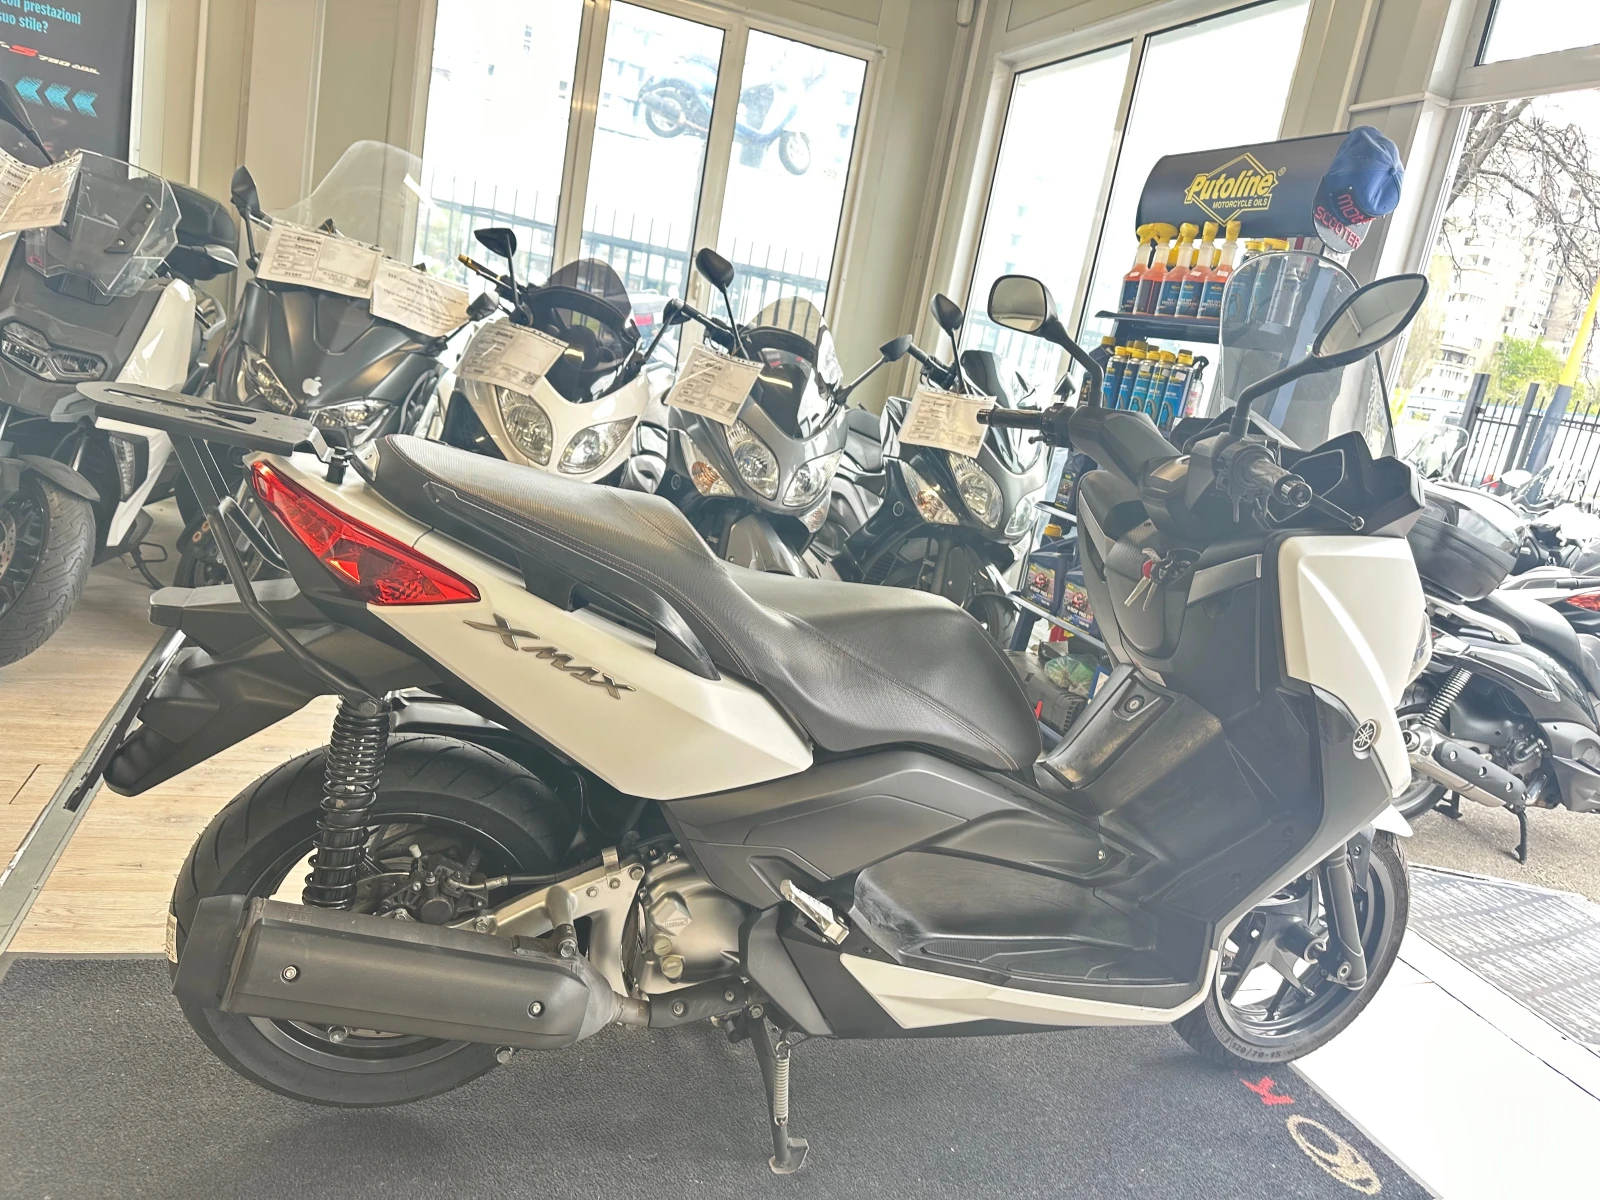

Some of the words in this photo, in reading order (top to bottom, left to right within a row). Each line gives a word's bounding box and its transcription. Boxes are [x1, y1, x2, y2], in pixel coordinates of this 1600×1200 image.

[18, 16, 48, 34] stile?
[23, 0, 81, 25] prestazioni
[1185, 170, 1276, 202] Putoline
[1212, 199, 1253, 209] MOTORCYCLE
[1253, 198, 1268, 206] OILS
[1314, 206, 1361, 250] SCOOTER
